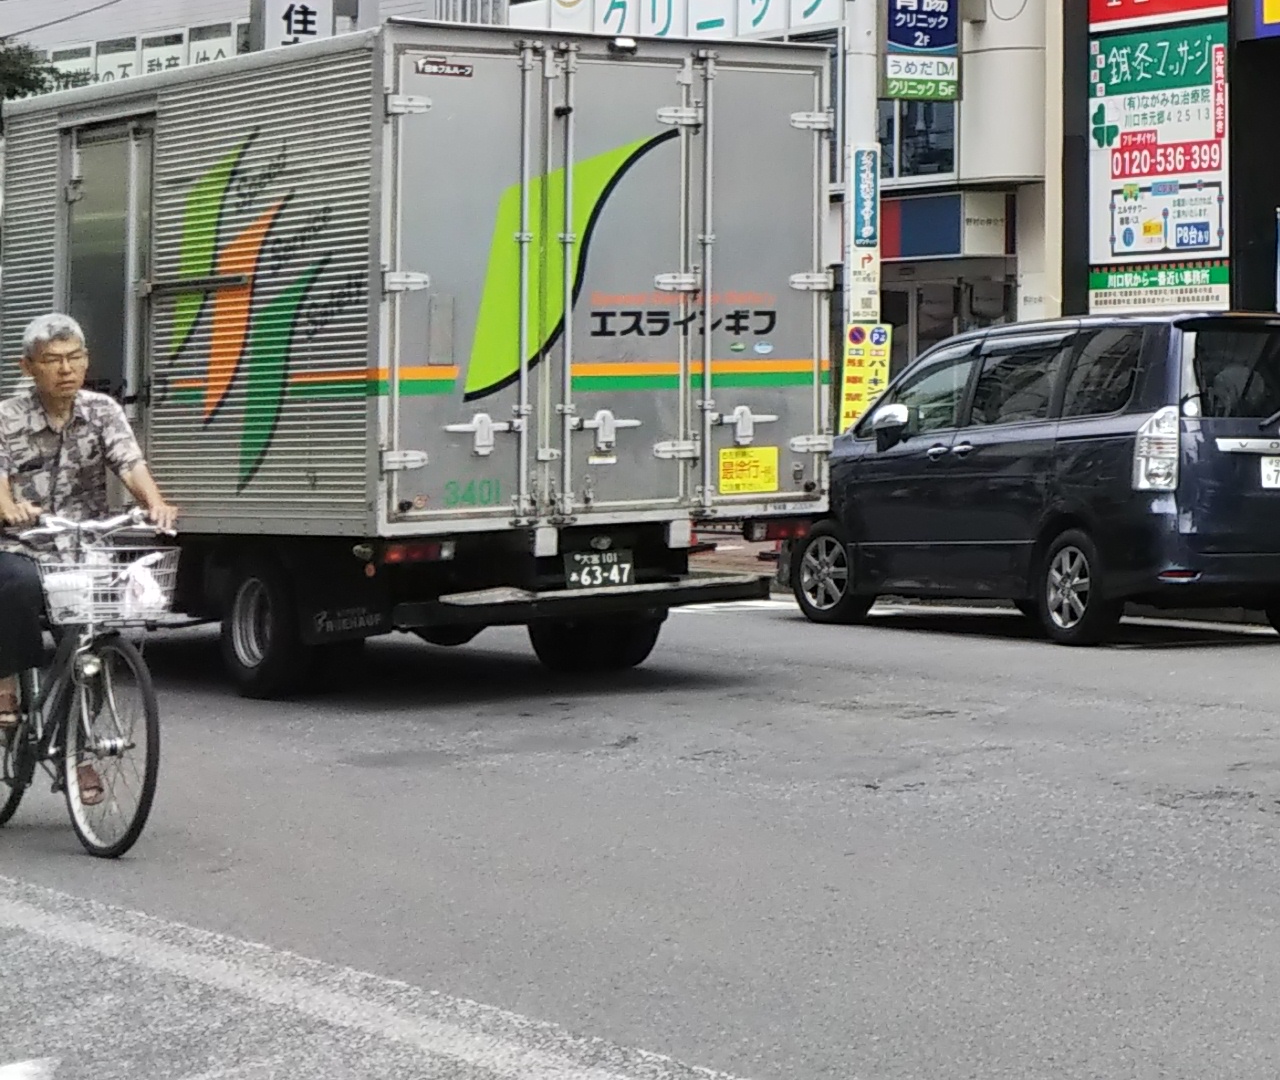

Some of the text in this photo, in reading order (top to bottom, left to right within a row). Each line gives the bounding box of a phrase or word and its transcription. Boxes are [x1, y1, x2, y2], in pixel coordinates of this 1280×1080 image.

[282, 3, 317, 47] 住
[895, 13, 949, 29] クリニック
[914, 32, 930, 47] 2F
[1113, 143, 1220, 175] 0120-536-399
[1177, 224, 1209, 245] P8台あり
[1107, 269, 1210, 288] 川口駅から一番近い事務所
[590, 310, 777, 337] エスラインギフ
[443, 479, 501, 507] 3401
[602, 552, 617, 564] 101
[580, 563, 631, 586] 63-47
